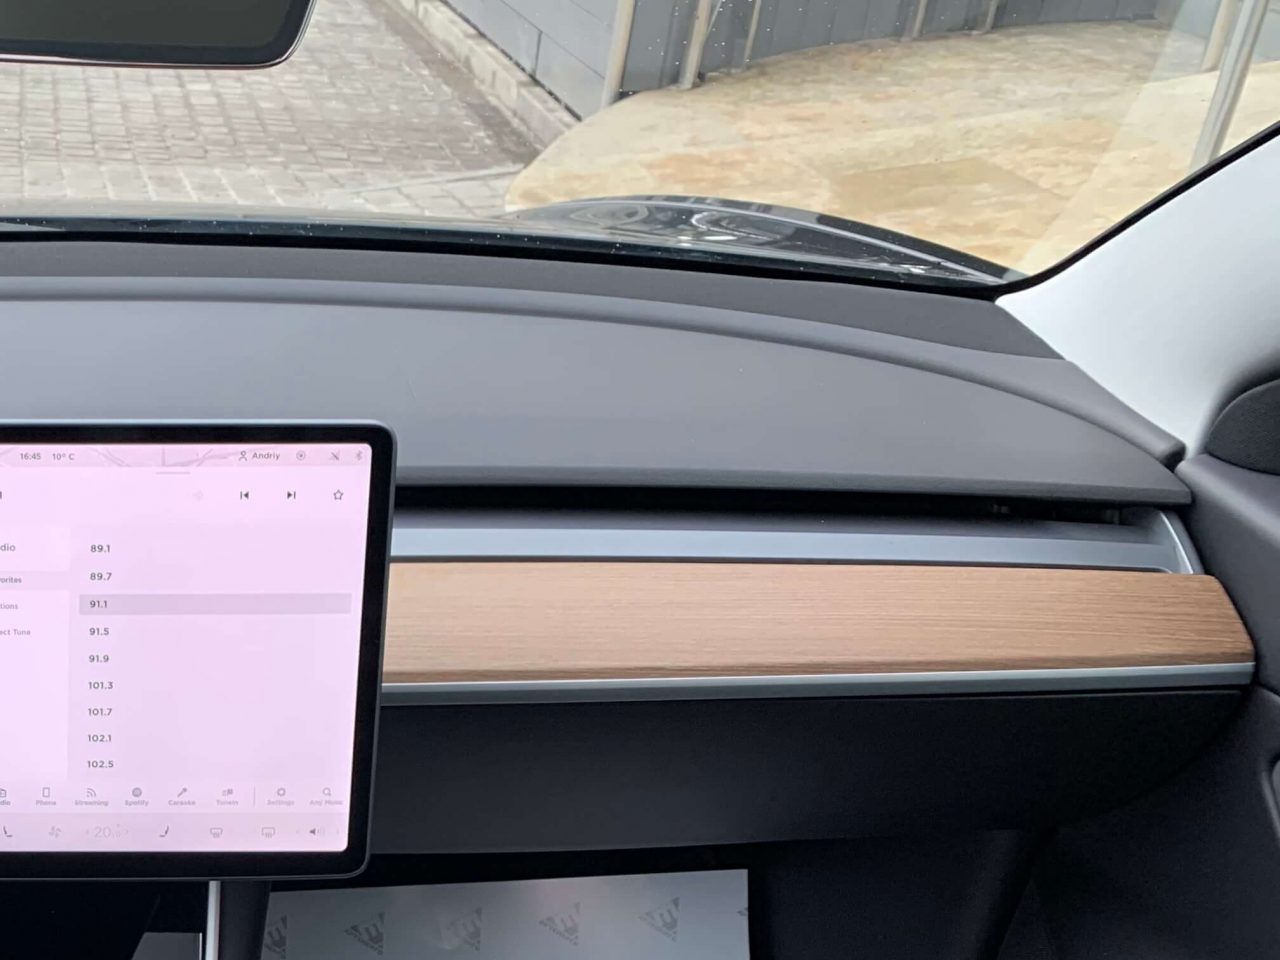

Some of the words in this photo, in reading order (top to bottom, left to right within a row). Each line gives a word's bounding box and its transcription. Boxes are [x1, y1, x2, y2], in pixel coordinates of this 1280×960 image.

[19, 452, 42, 460] 16:45
[251, 451, 281, 461] Andriy
[90, 544, 111, 553] 89.1
[90, 572, 112, 581] 89.7
[89, 600, 108, 608] 91.1
[13, 628, 31, 636] Tune
[89, 627, 110, 636] 91.5
[88, 654, 110, 663] 91.9
[88, 681, 114, 690] 101.3
[87, 708, 113, 716] 101.7
[87, 734, 112, 743] 102.1
[87, 760, 114, 768] 102.5
